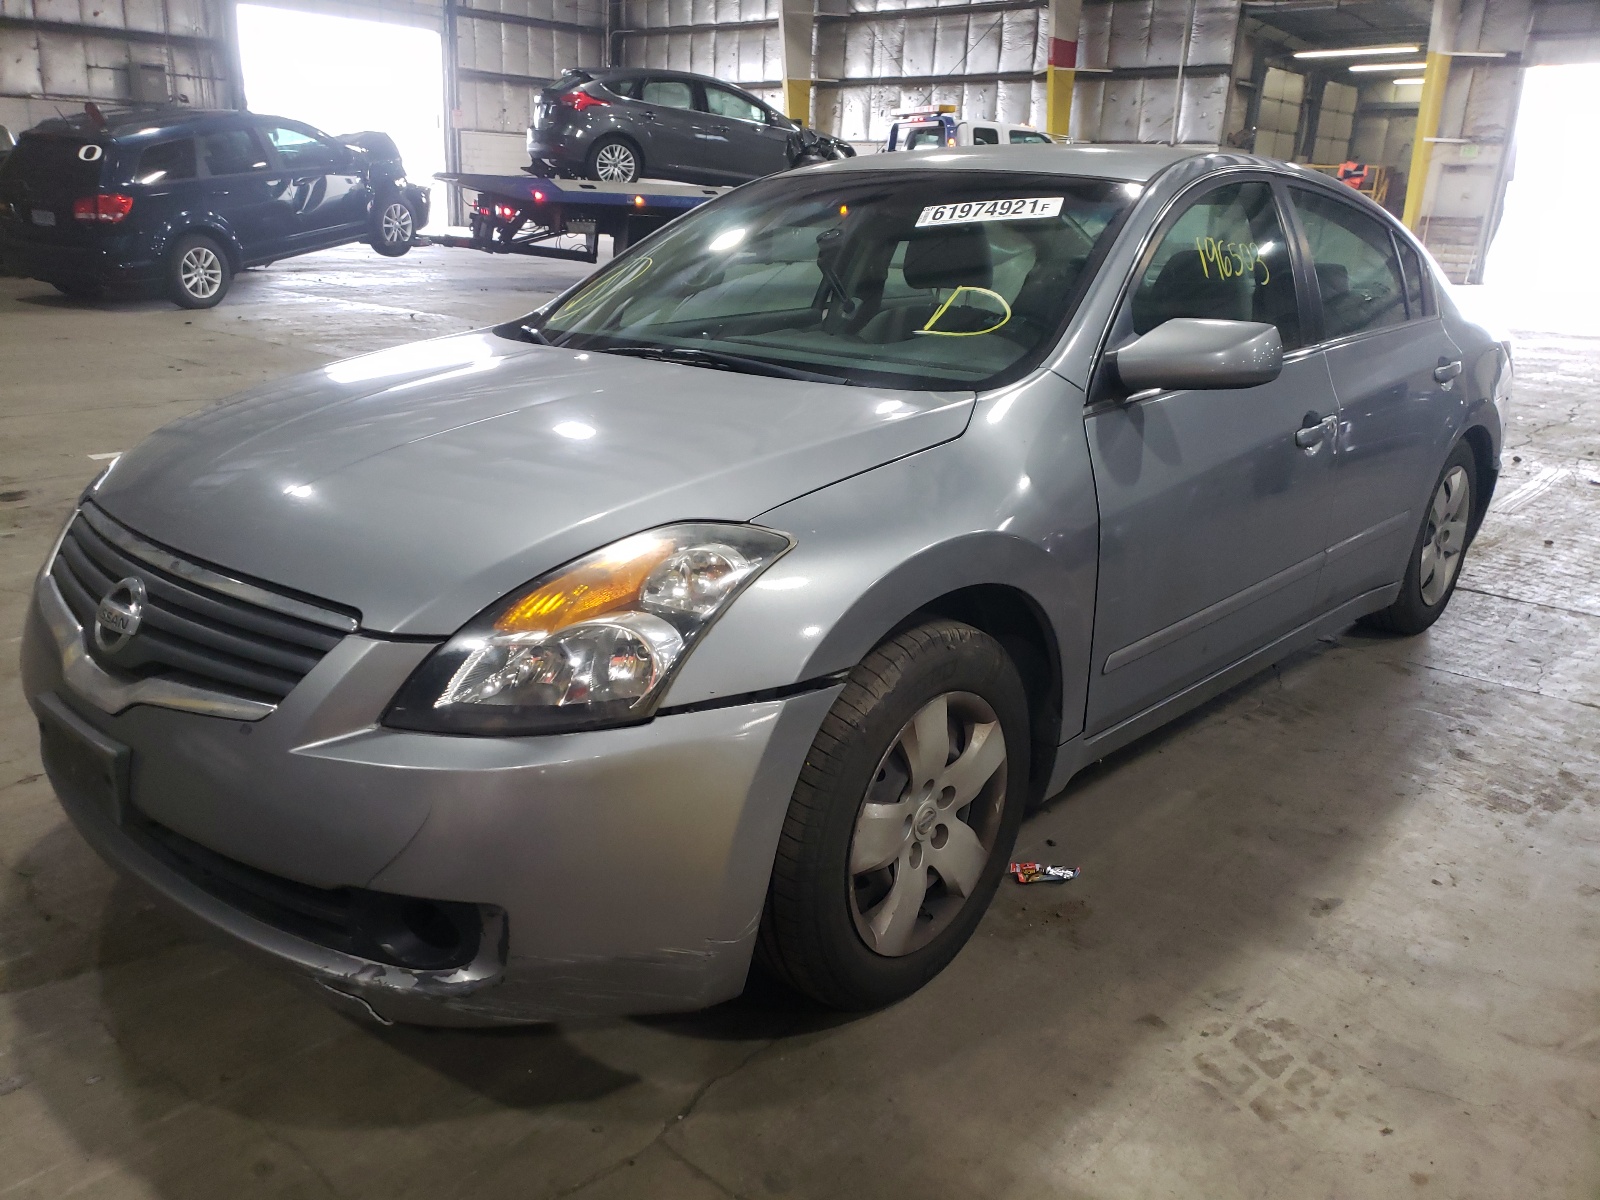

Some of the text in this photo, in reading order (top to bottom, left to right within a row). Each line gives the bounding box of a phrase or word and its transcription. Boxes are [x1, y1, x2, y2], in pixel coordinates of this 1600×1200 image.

[931, 199, 1051, 221] 61974921 F
[1196, 237, 1270, 286] 196503
[98, 607, 130, 630] SSAN
